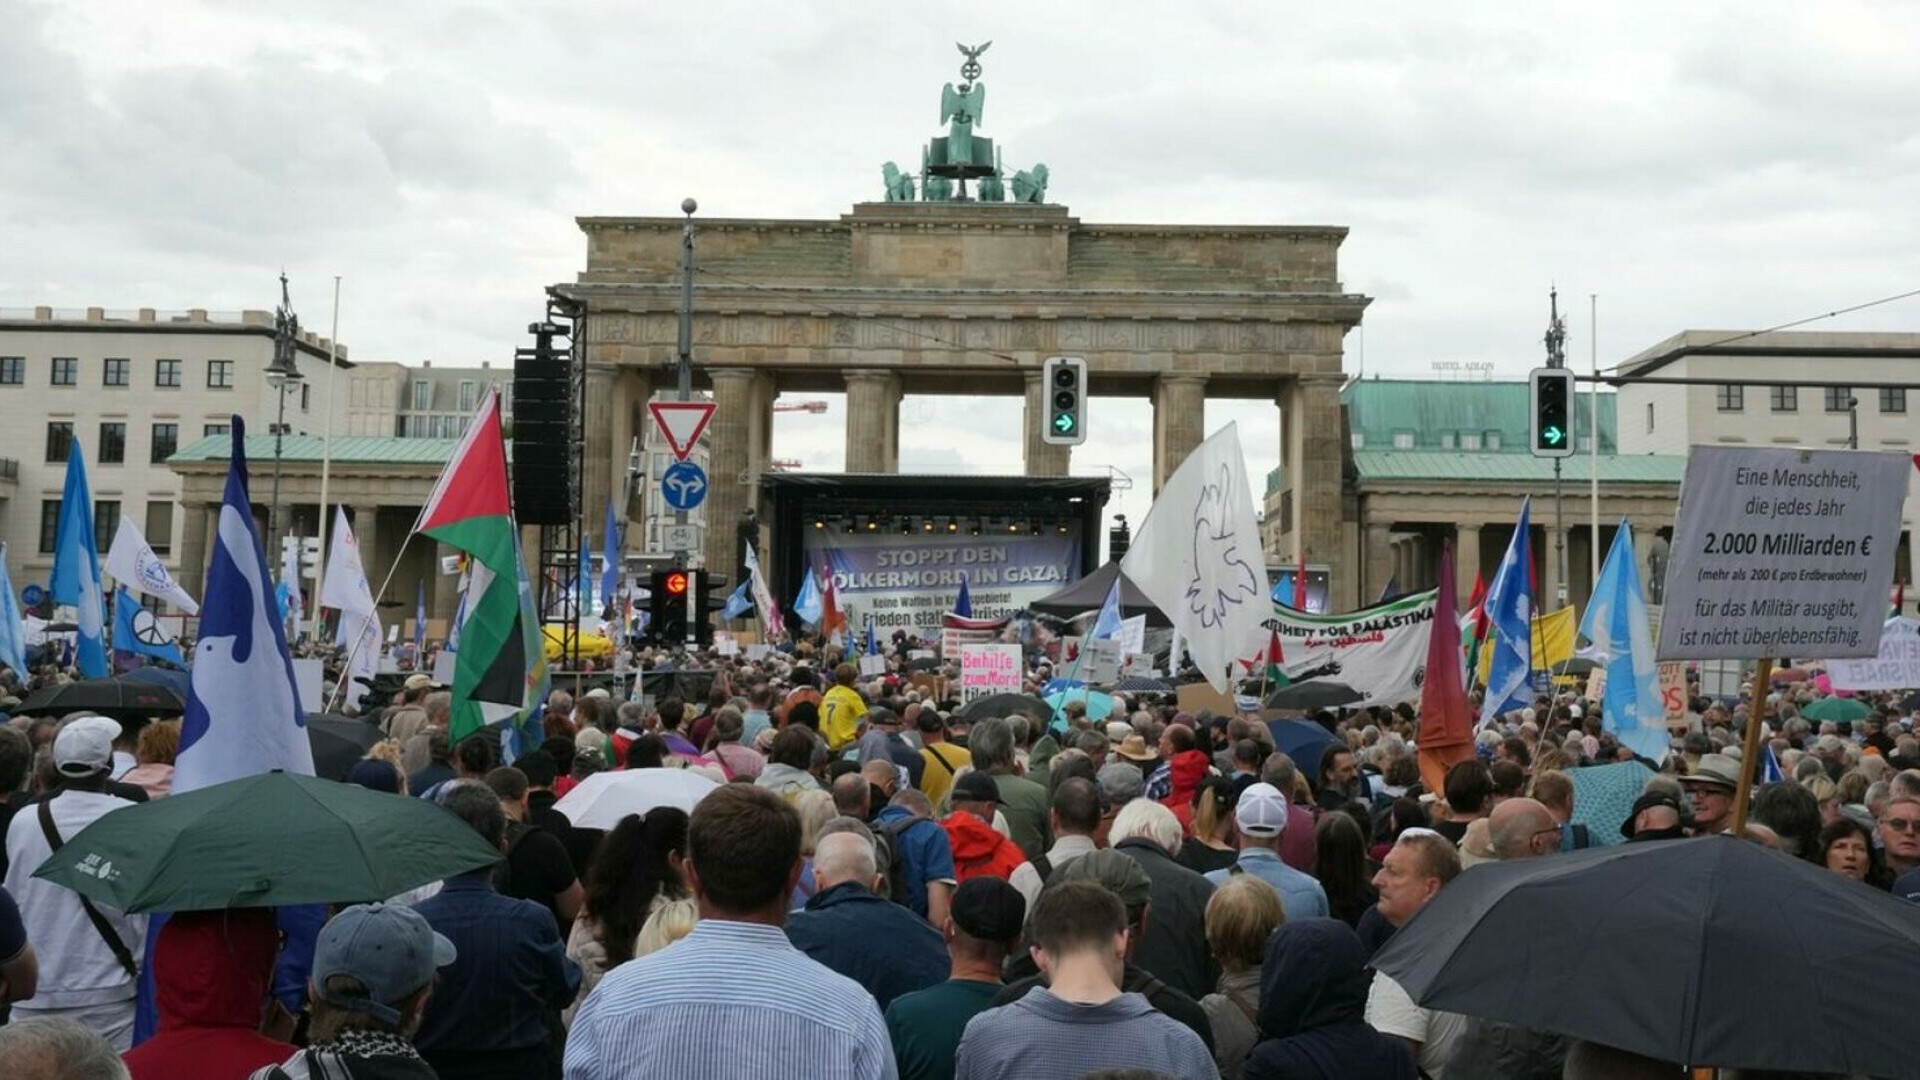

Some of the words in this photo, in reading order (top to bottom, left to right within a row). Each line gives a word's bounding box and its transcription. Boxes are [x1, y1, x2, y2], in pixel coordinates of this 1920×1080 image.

[1431, 362, 1461, 370] HOTEL
[1464, 362, 1495, 371] ADLON
[1736, 467, 1768, 486] Eine
[1772, 468, 1861, 491] Menschheit,
[1746, 496, 1769, 515] die
[1770, 497, 1812, 519] jedes
[1814, 499, 1846, 516] Jahr
[1704, 532, 1757, 554] 2.000
[1762, 533, 1856, 556] Milliarden
[1860, 535, 1873, 556] €
[877, 549, 957, 568] STOPPT
[963, 547, 1008, 564] DEN
[974, 567, 998, 584] IN
[1003, 564, 1069, 583] GAZA!
[1698, 568, 1730, 583] (mehr
[1732, 569, 1746, 581] als
[1751, 569, 1770, 581] 200
[1772, 569, 1778, 581] €
[1779, 571, 1797, 584] pro
[1799, 569, 1868, 584] Erdbewohner)
[872, 598, 898, 609] Keine
[900, 596, 932, 607] Waffen
[934, 595, 943, 605] in
[1695, 598, 1718, 617] für
[1720, 598, 1746, 617] das
[1751, 599, 1800, 617] Militär
[1803, 600, 1858, 621] ausgibt,
[862, 611, 911, 627] Frieden
[1321, 624, 1349, 637] FÜR
[1679, 629, 1697, 646] ist
[1701, 628, 1739, 645] nicht
[1742, 627, 1862, 648] überlebensfähig.
[987, 670, 1020, 686] Mord
